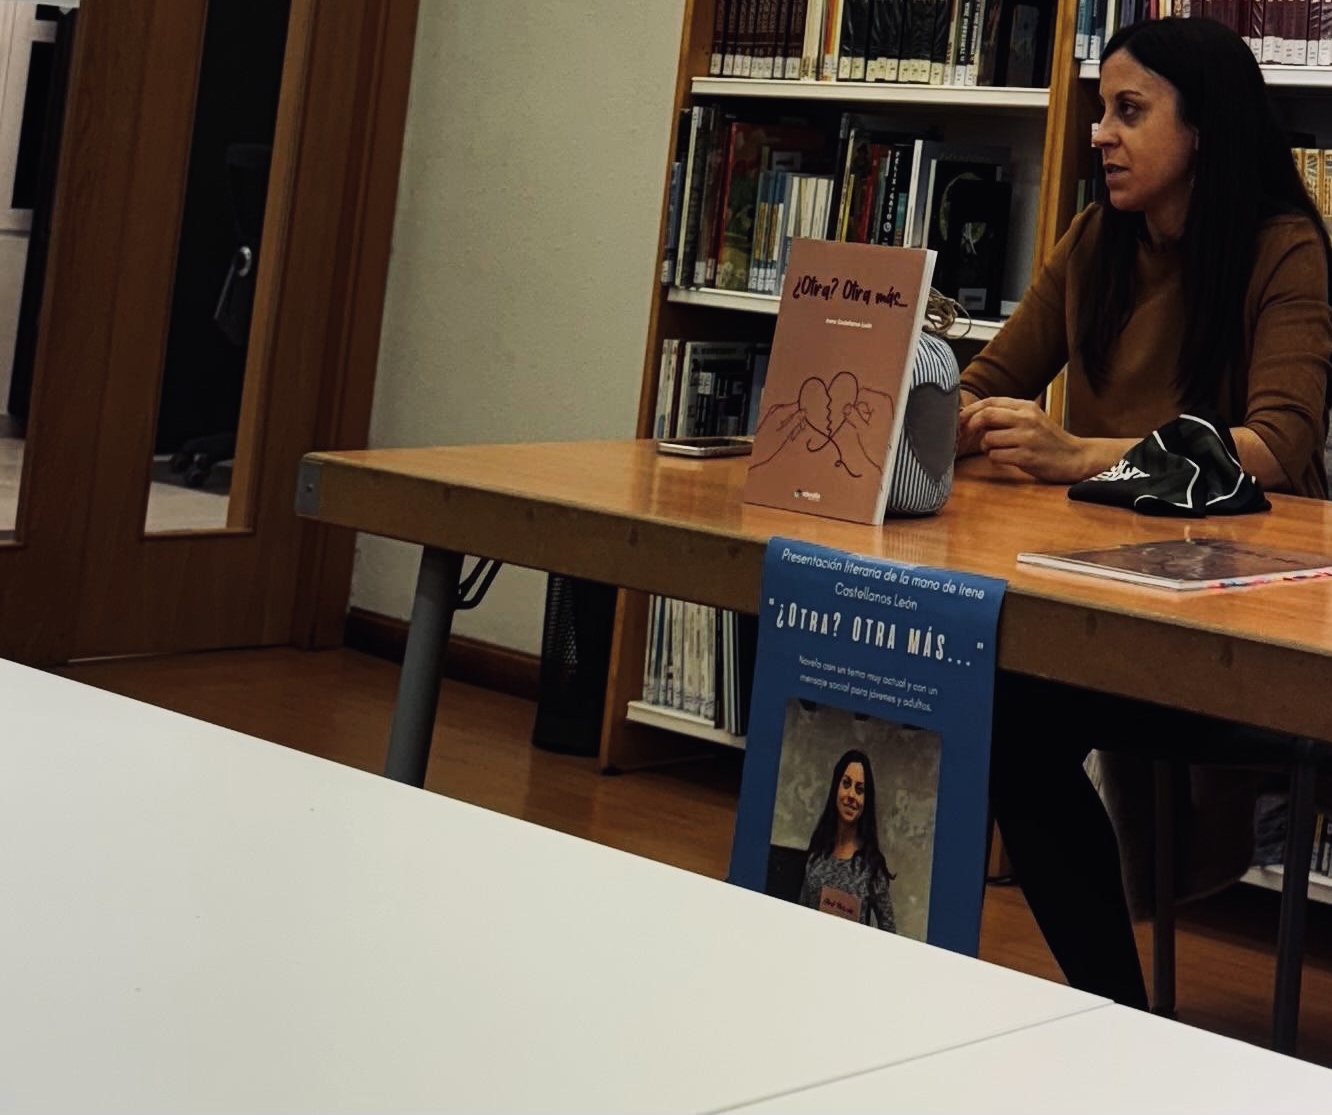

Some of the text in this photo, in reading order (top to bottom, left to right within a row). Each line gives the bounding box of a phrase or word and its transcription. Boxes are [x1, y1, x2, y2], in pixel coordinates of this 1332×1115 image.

[792, 274, 838, 301] ¿Otra?
[842, 281, 871, 306] Otra
[781, 548, 985, 600] Presentación literaria de la mano de Irene
[834, 582, 918, 611] Castellanos León
[852, 616, 896, 650] OTRA
[799, 655, 938, 696] Novela con un tema muy actual y con un
[799, 673, 932, 712] mensaje social para jóvenes y adultos.
